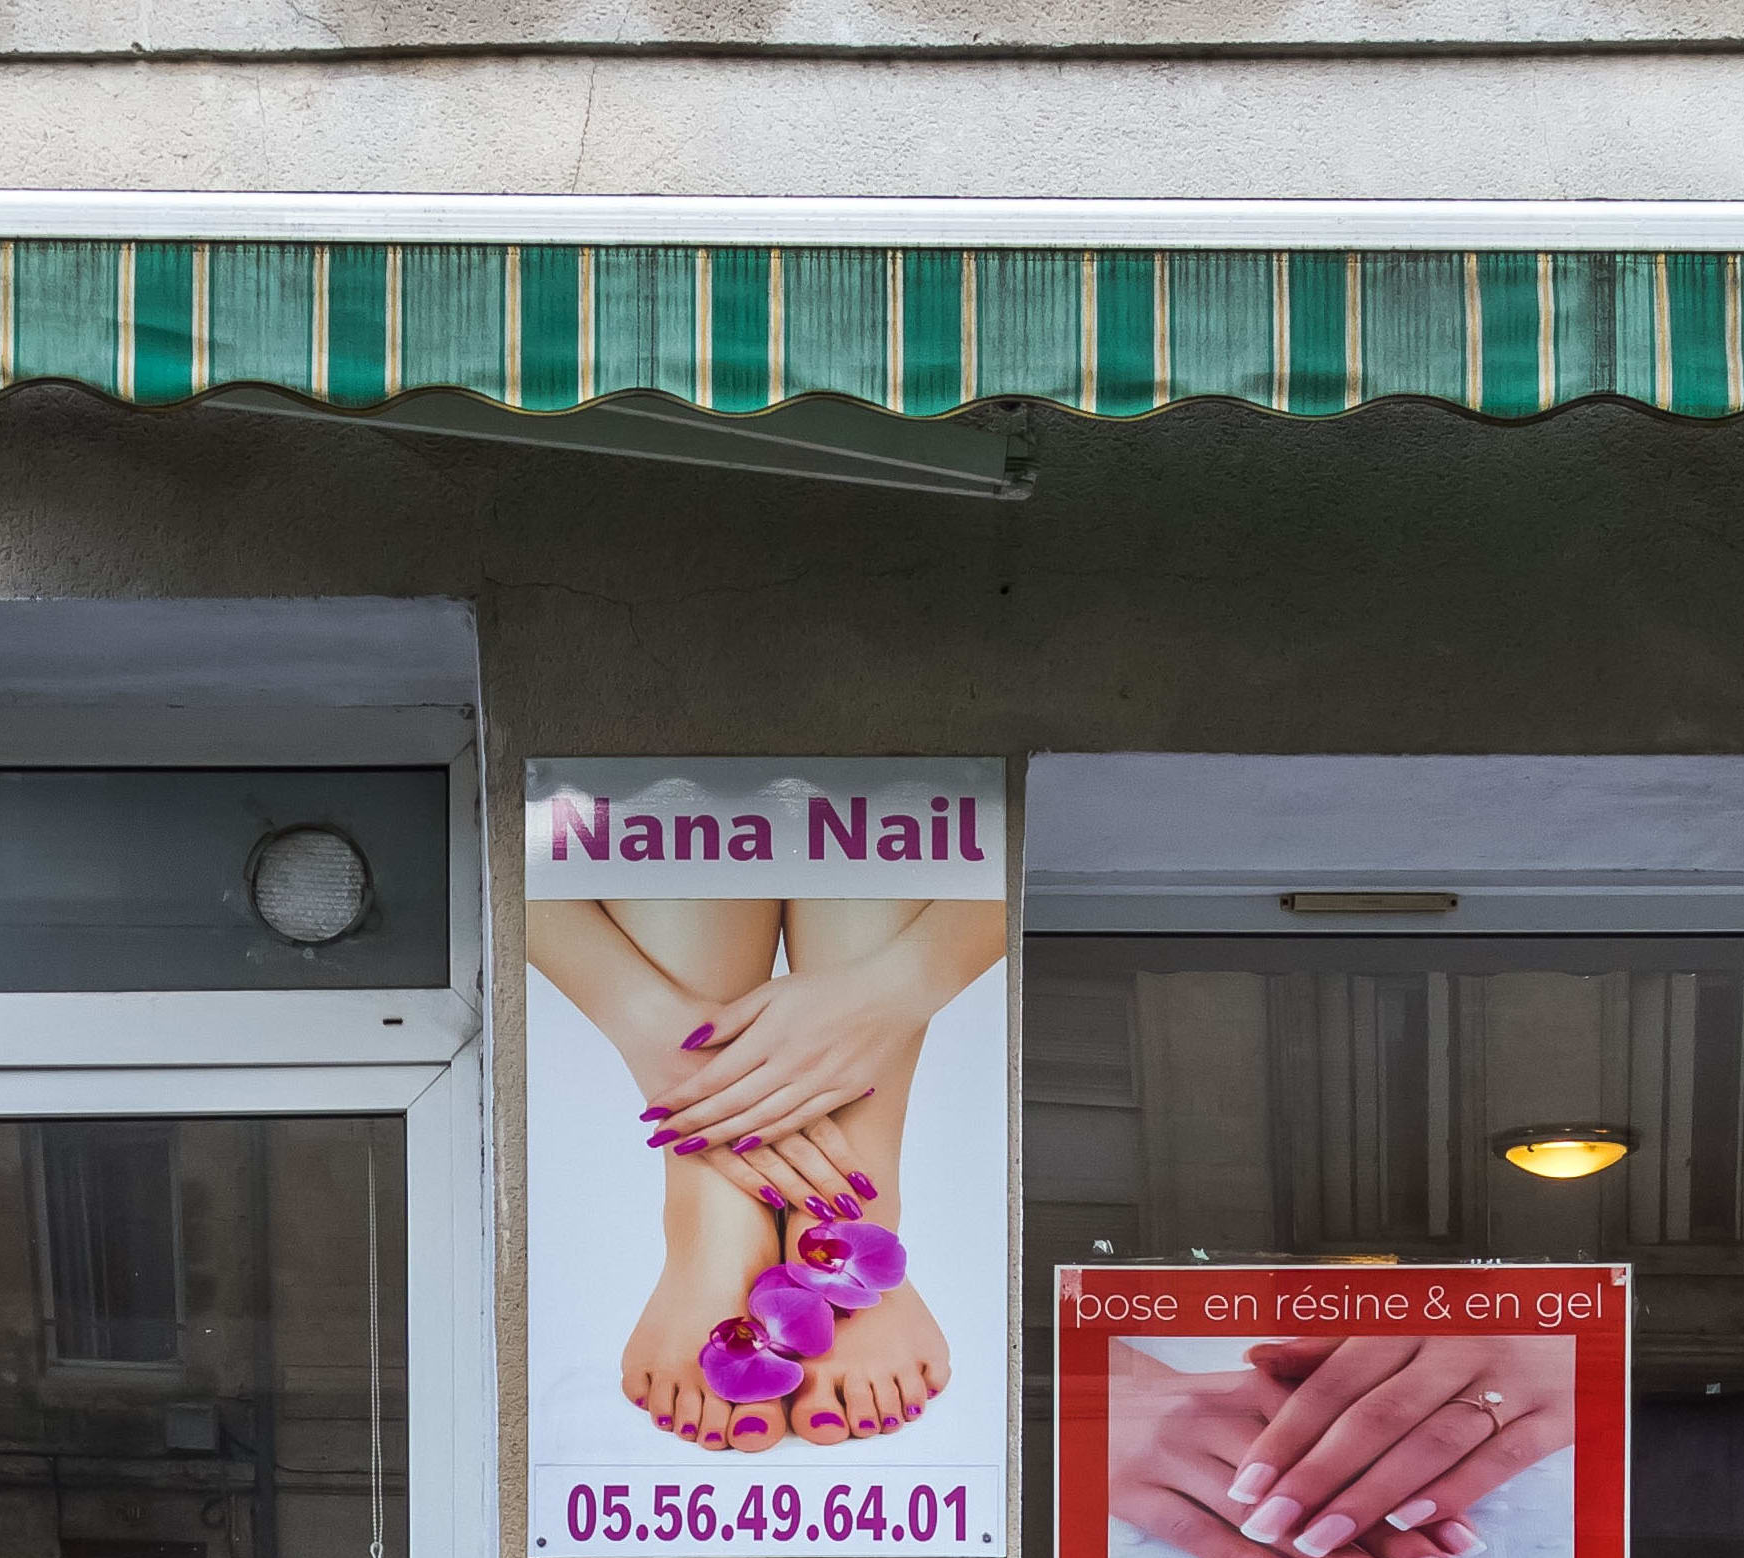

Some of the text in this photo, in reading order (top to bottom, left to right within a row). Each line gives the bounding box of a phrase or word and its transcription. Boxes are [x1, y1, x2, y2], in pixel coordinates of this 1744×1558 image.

[551, 796, 985, 862] Nana Nail
[1075, 1283, 1602, 1328] pose en résine & en gel
[566, 1484, 967, 1543] 05.56.49.64.01
